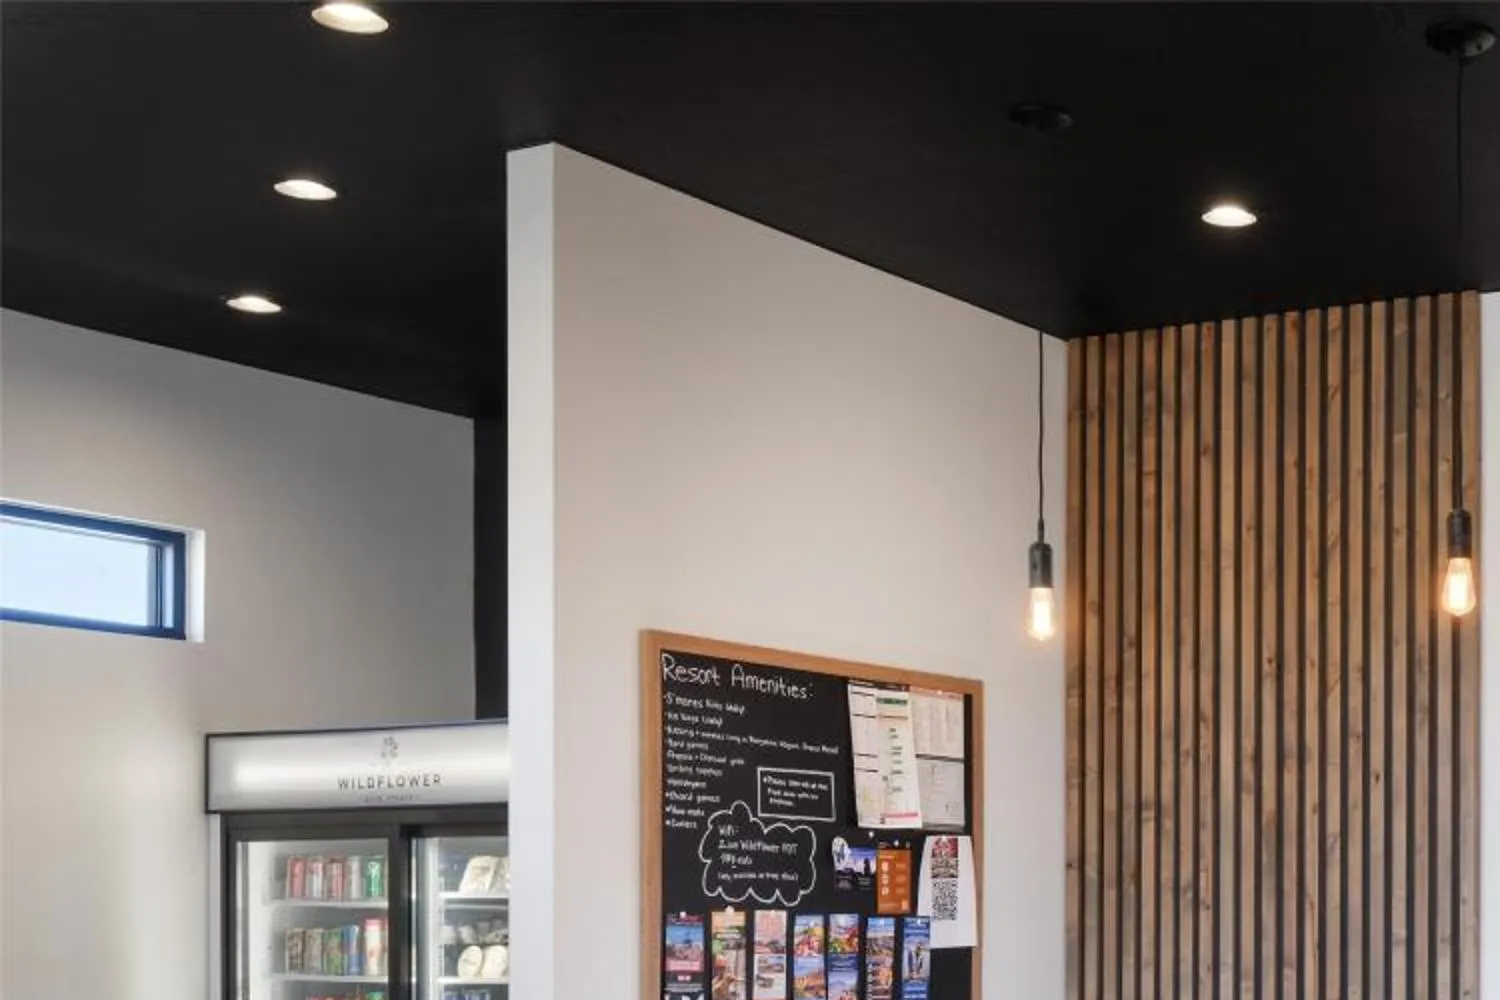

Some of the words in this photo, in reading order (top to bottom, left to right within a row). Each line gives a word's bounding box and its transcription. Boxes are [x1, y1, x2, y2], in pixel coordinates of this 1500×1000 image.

[662, 653, 721, 686] Resort
[731, 663, 814, 699] Amenities:
[338, 774, 441, 790] WILDFLOWER
